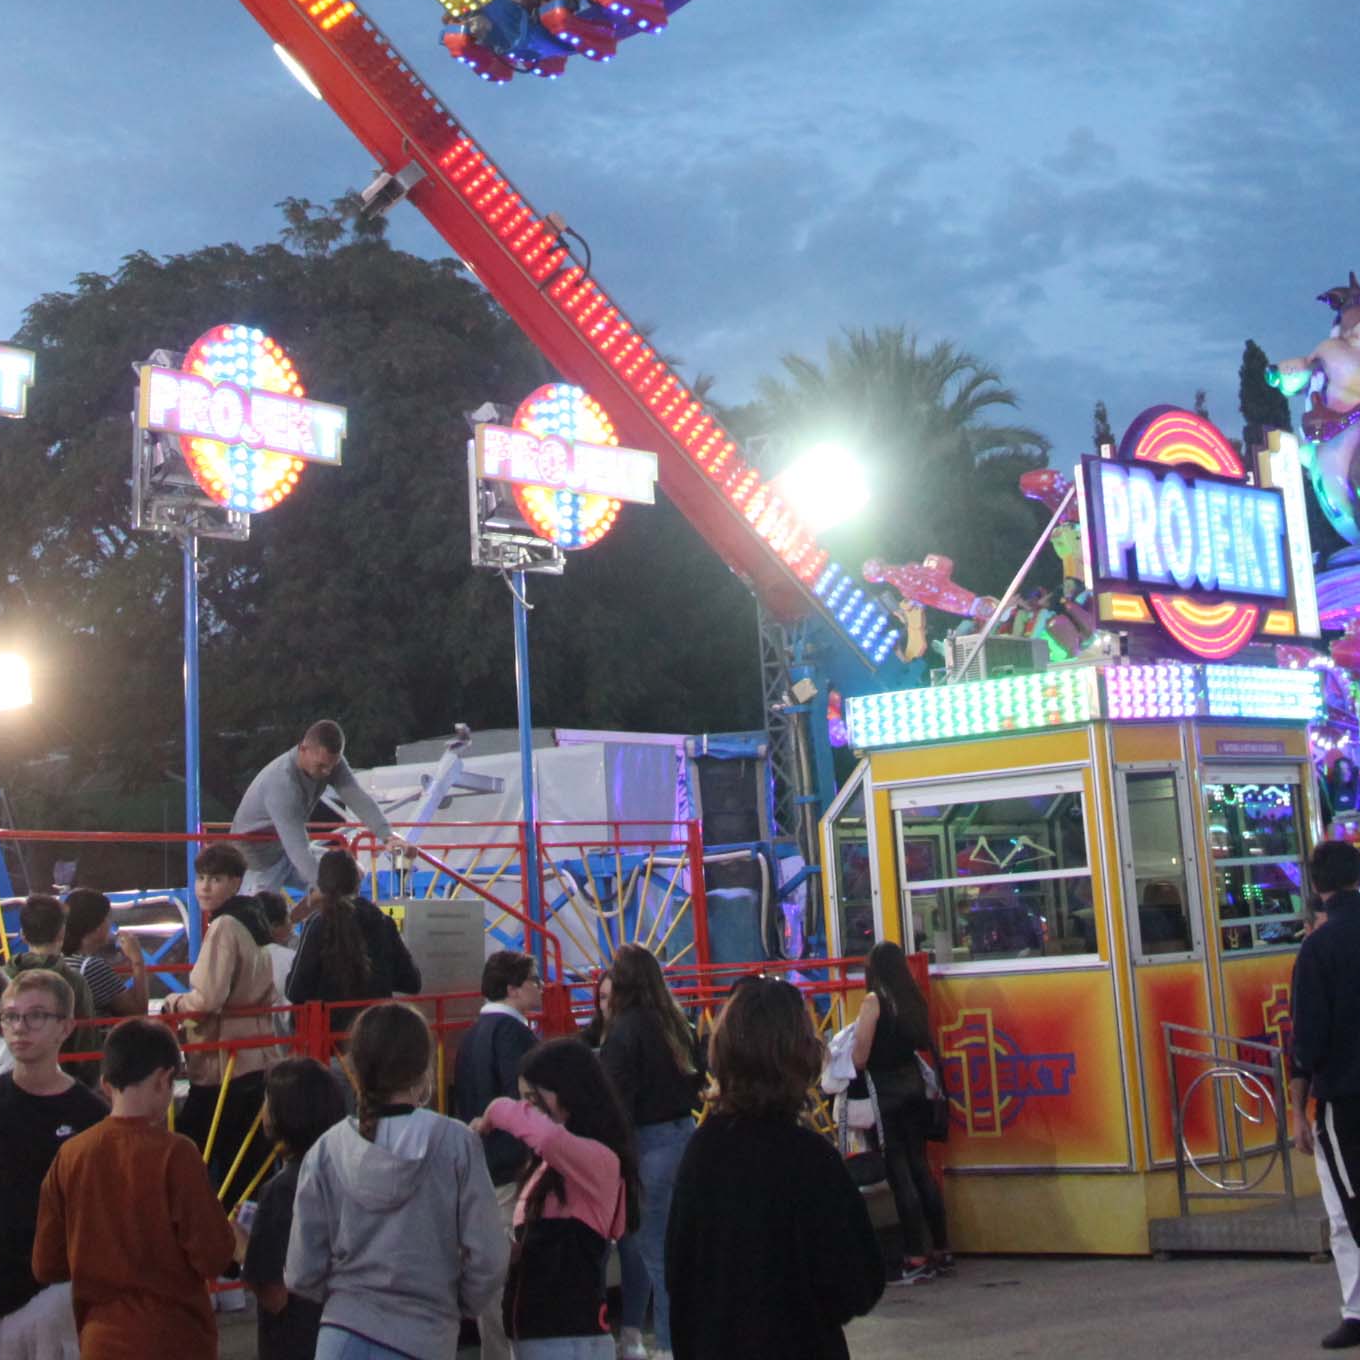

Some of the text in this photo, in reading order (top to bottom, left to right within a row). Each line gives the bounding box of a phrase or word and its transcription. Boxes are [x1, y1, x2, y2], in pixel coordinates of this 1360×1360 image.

[483, 429, 658, 504] PROJ
[1100, 462, 1281, 591] PROJEKT
[943, 1059, 1070, 1092] OJEKT
